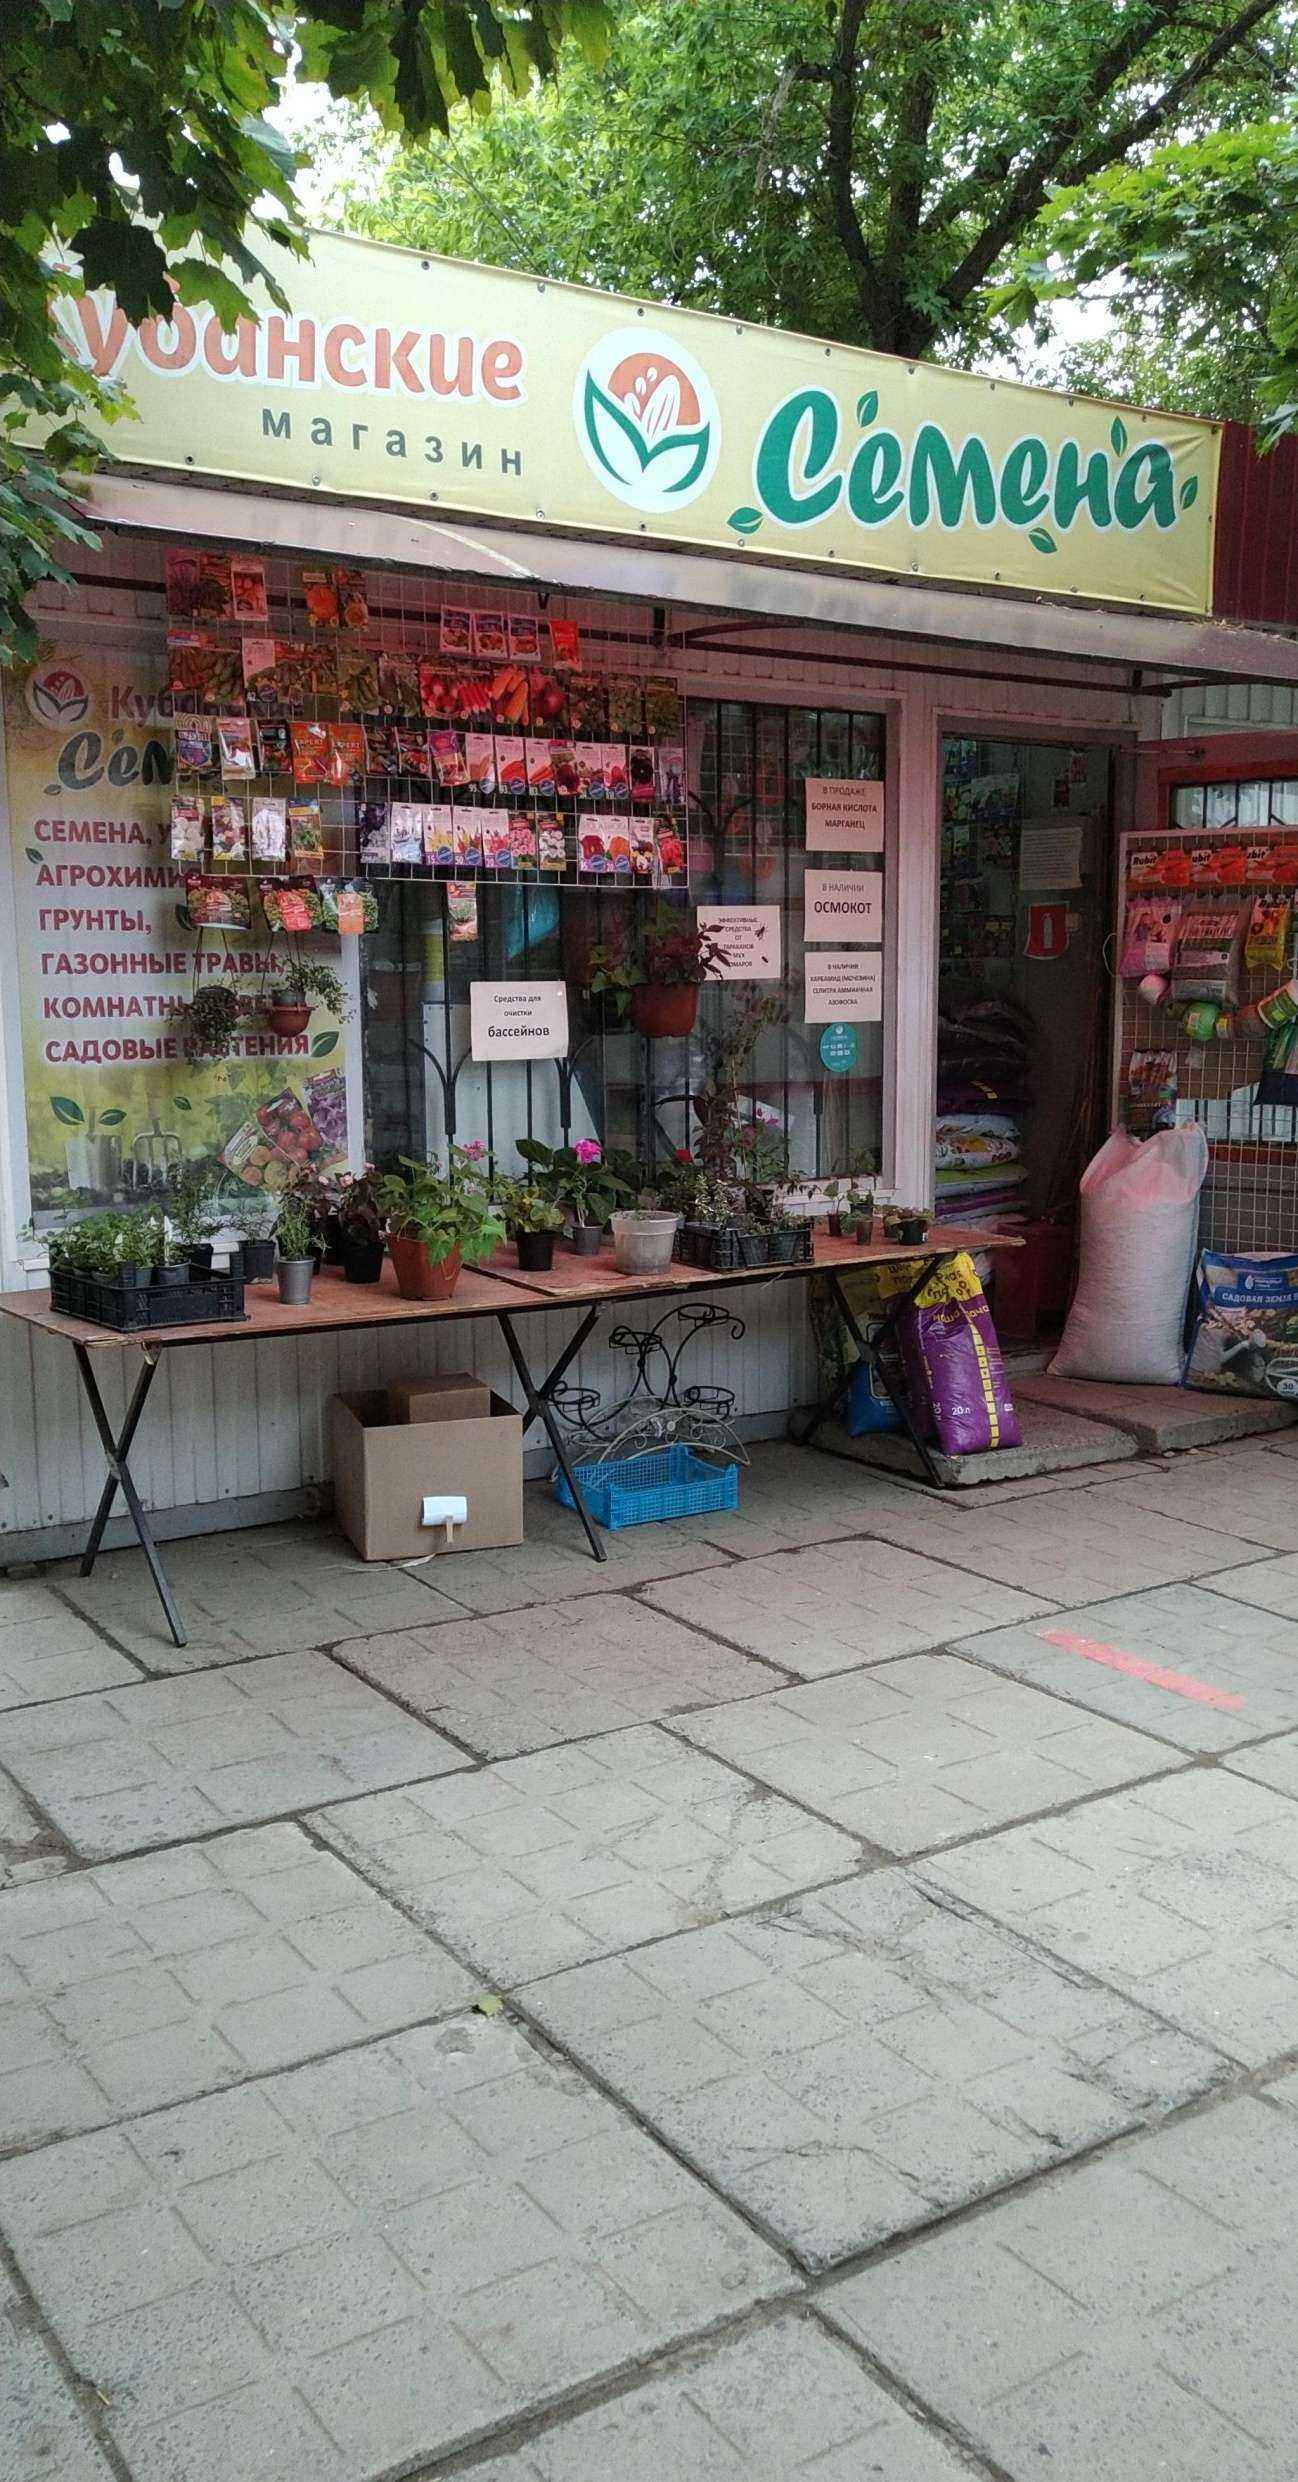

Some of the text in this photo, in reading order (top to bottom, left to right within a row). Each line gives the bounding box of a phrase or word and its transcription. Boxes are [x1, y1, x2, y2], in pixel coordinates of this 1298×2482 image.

[262, 408, 523, 476] магазин
[756, 388, 1178, 531] Семена
[829, 786, 865, 797] ПРОДАЖЕ
[811, 802, 878, 813] БОРНАЯ КИСЛОТА
[825, 819, 866, 830] МАРГАНЕЦ
[829, 883, 865, 893] НАЛИЧИИ
[814, 901, 873, 914] ОСМОКОТ
[39, 908, 152, 936] ГРУНТЫ,
[41, 952, 187, 975] ГАЗОННЫЕ
[493, 994, 542, 1004] Средства для
[44, 994, 196, 1020] КОМНАТН
[504, 1009, 533, 1017] очистки
[488, 1025, 550, 1038] бассейнов
[46, 1037, 177, 1064] САДОВЫЕ
